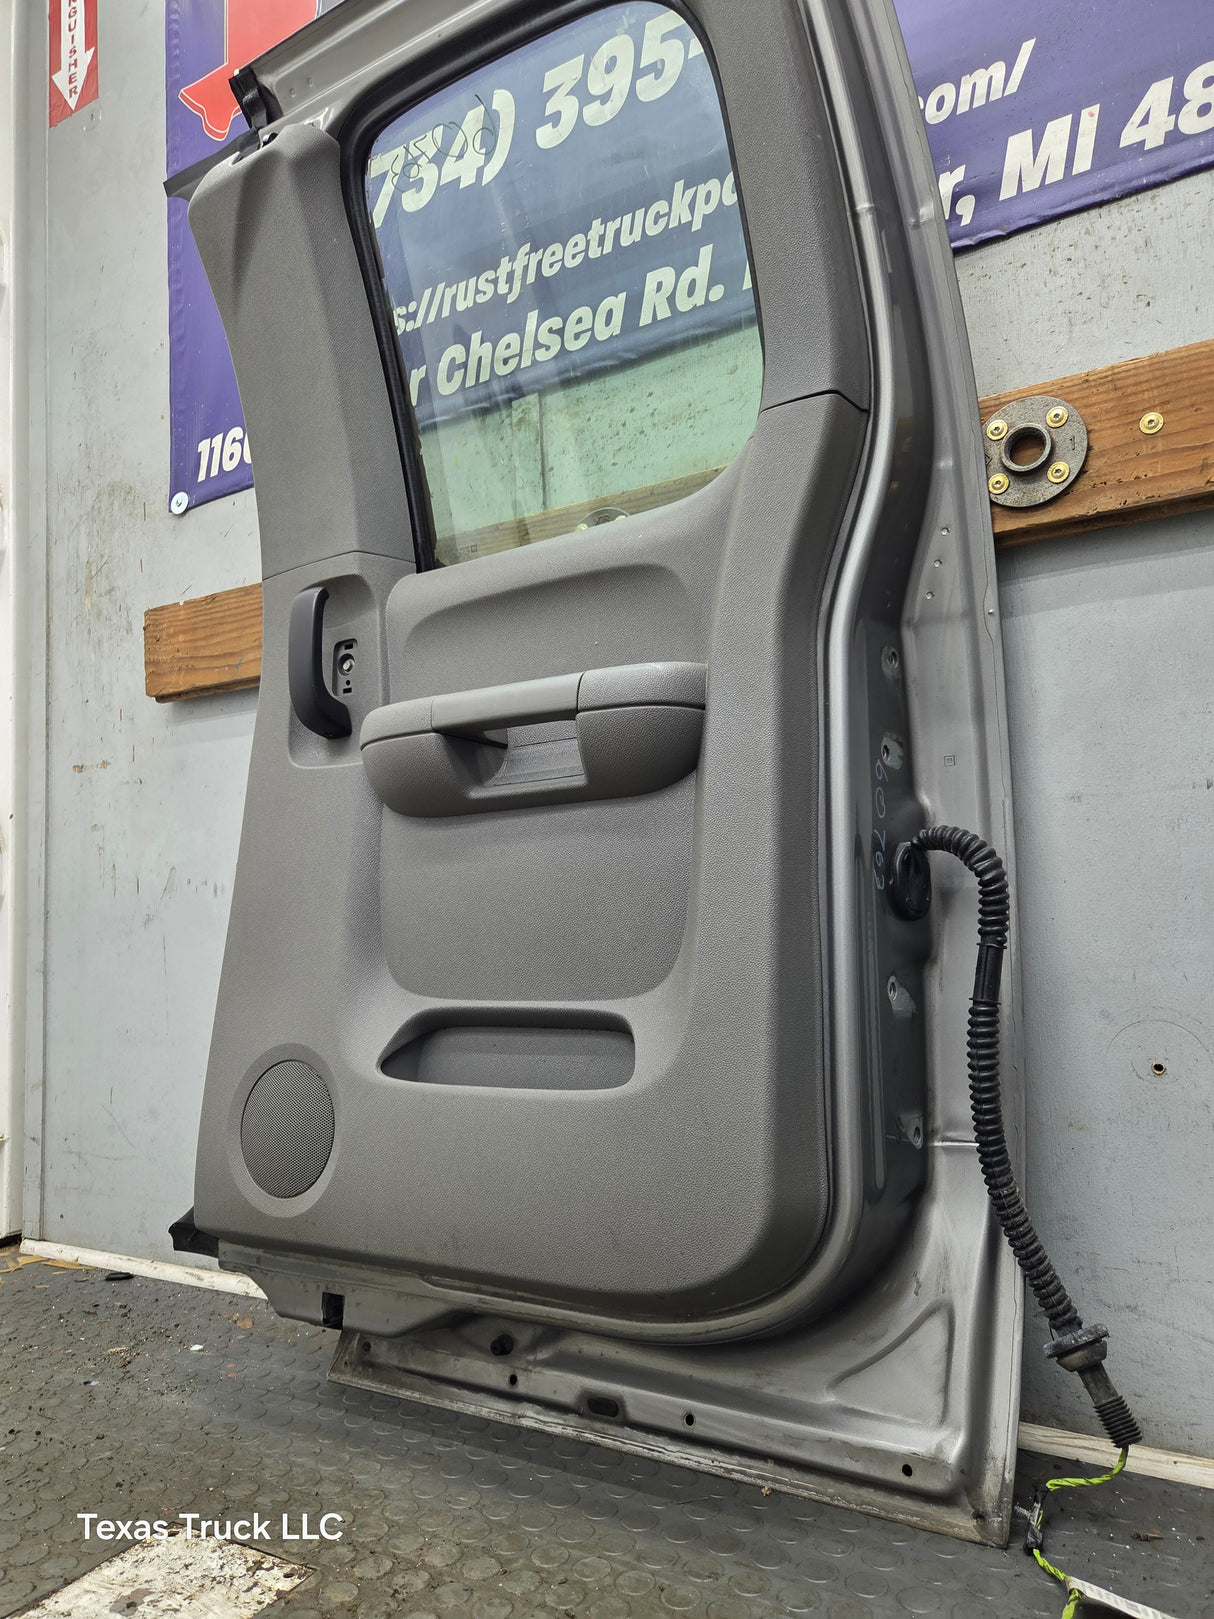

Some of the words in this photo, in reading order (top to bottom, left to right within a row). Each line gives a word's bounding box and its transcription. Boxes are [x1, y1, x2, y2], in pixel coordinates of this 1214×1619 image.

[918, 37, 1037, 125] om/
[436, 291, 627, 396] Chelsea
[639, 243, 725, 328] Rd.
[999, 103, 1100, 202] MI
